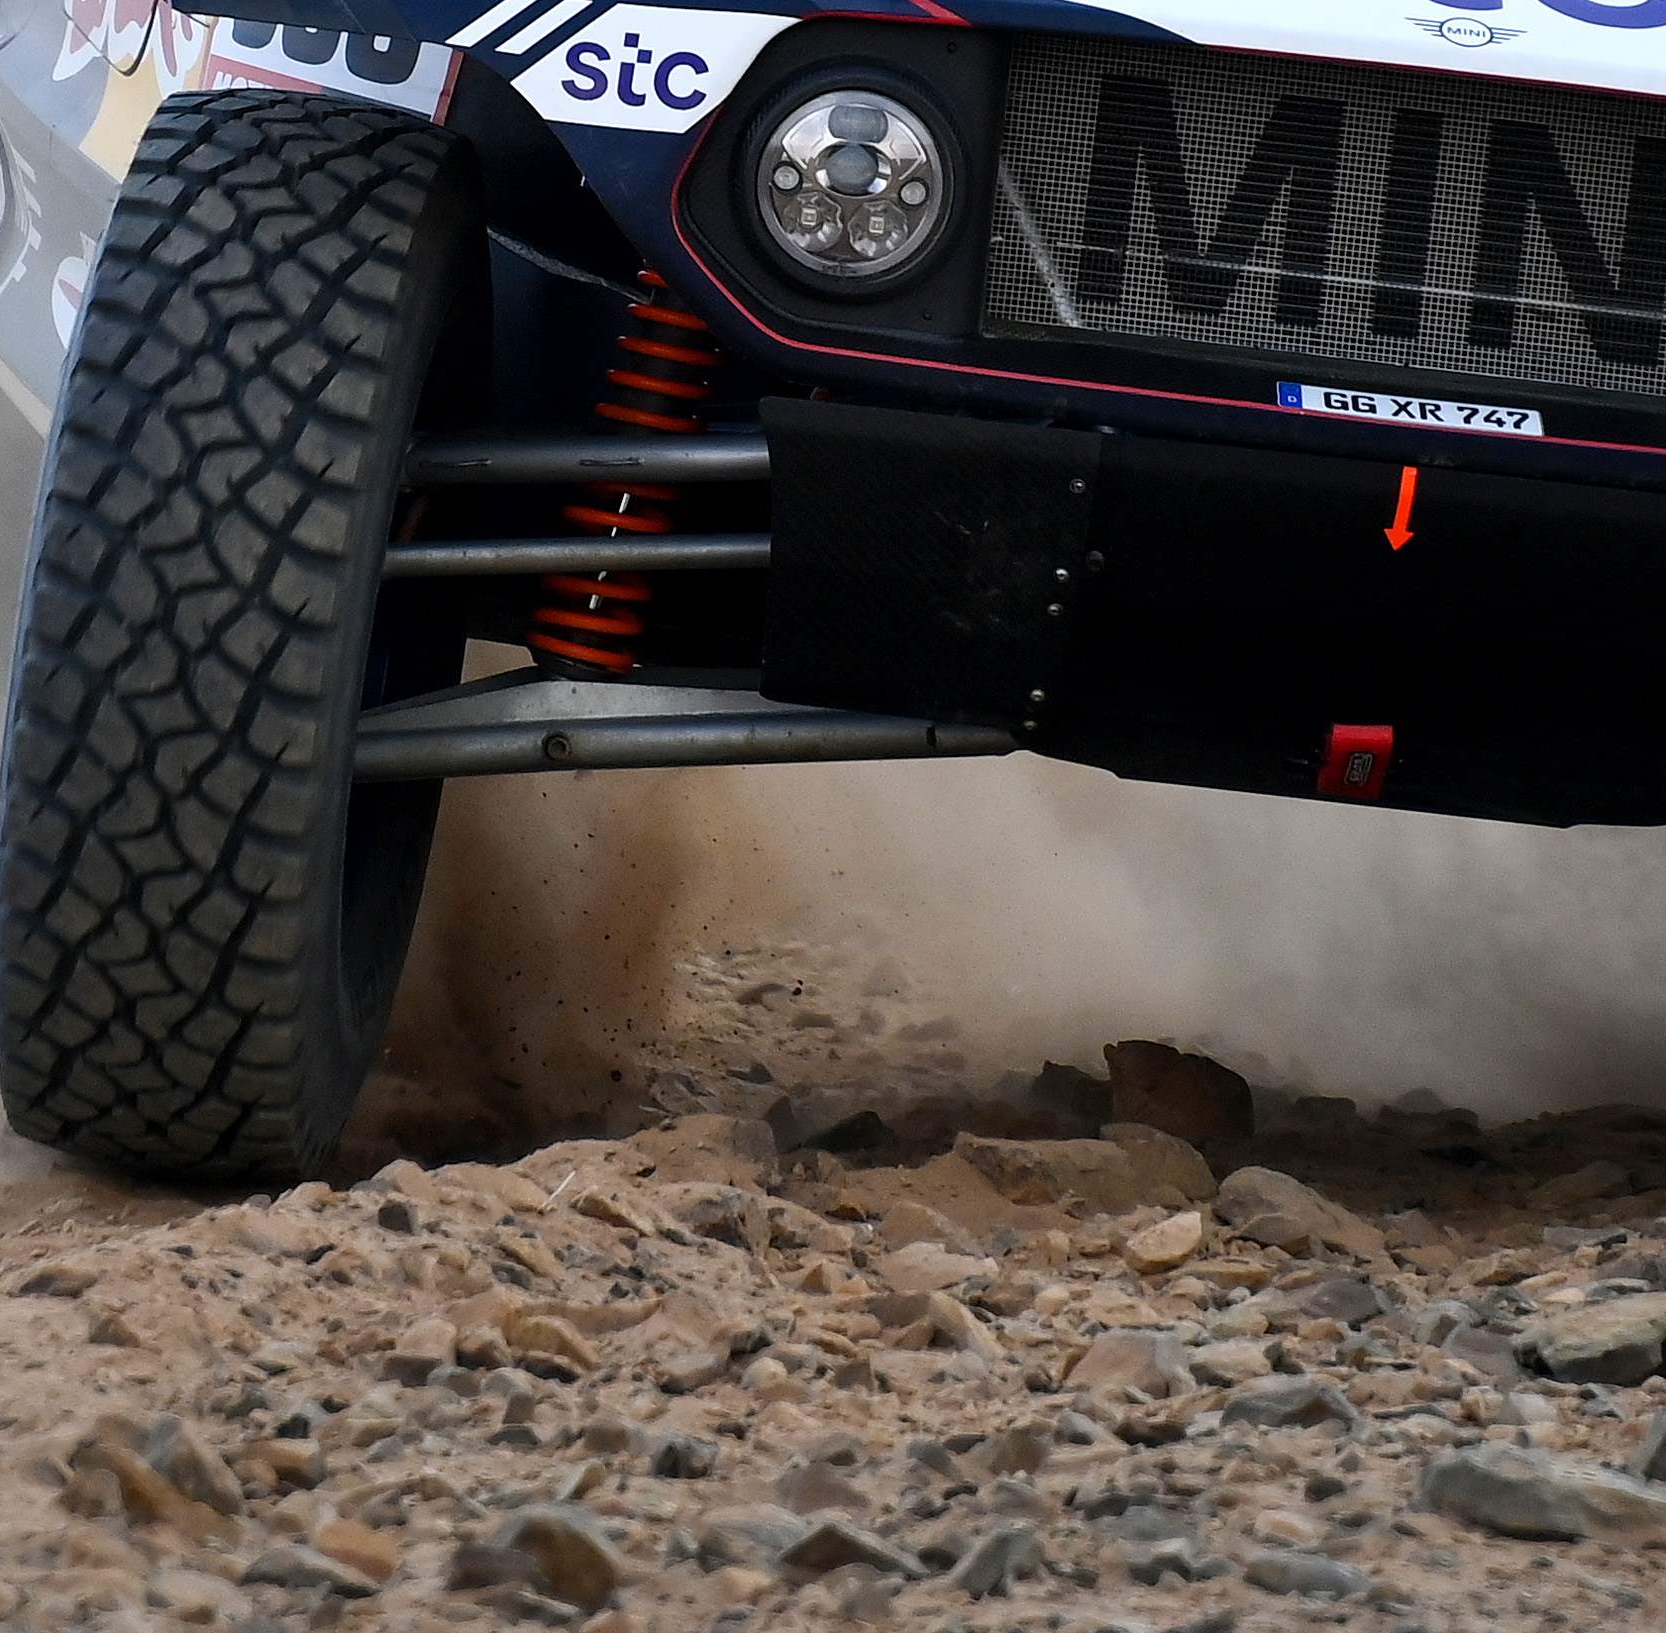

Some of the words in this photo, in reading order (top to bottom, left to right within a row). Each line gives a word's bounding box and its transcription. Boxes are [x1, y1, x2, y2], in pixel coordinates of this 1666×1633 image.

[1446, 26, 1487, 39] MINI
[561, 32, 710, 111] stc
[1323, 391, 1378, 415] GG
[1390, 398, 1445, 422] XR
[1456, 405, 1530, 430] 747
